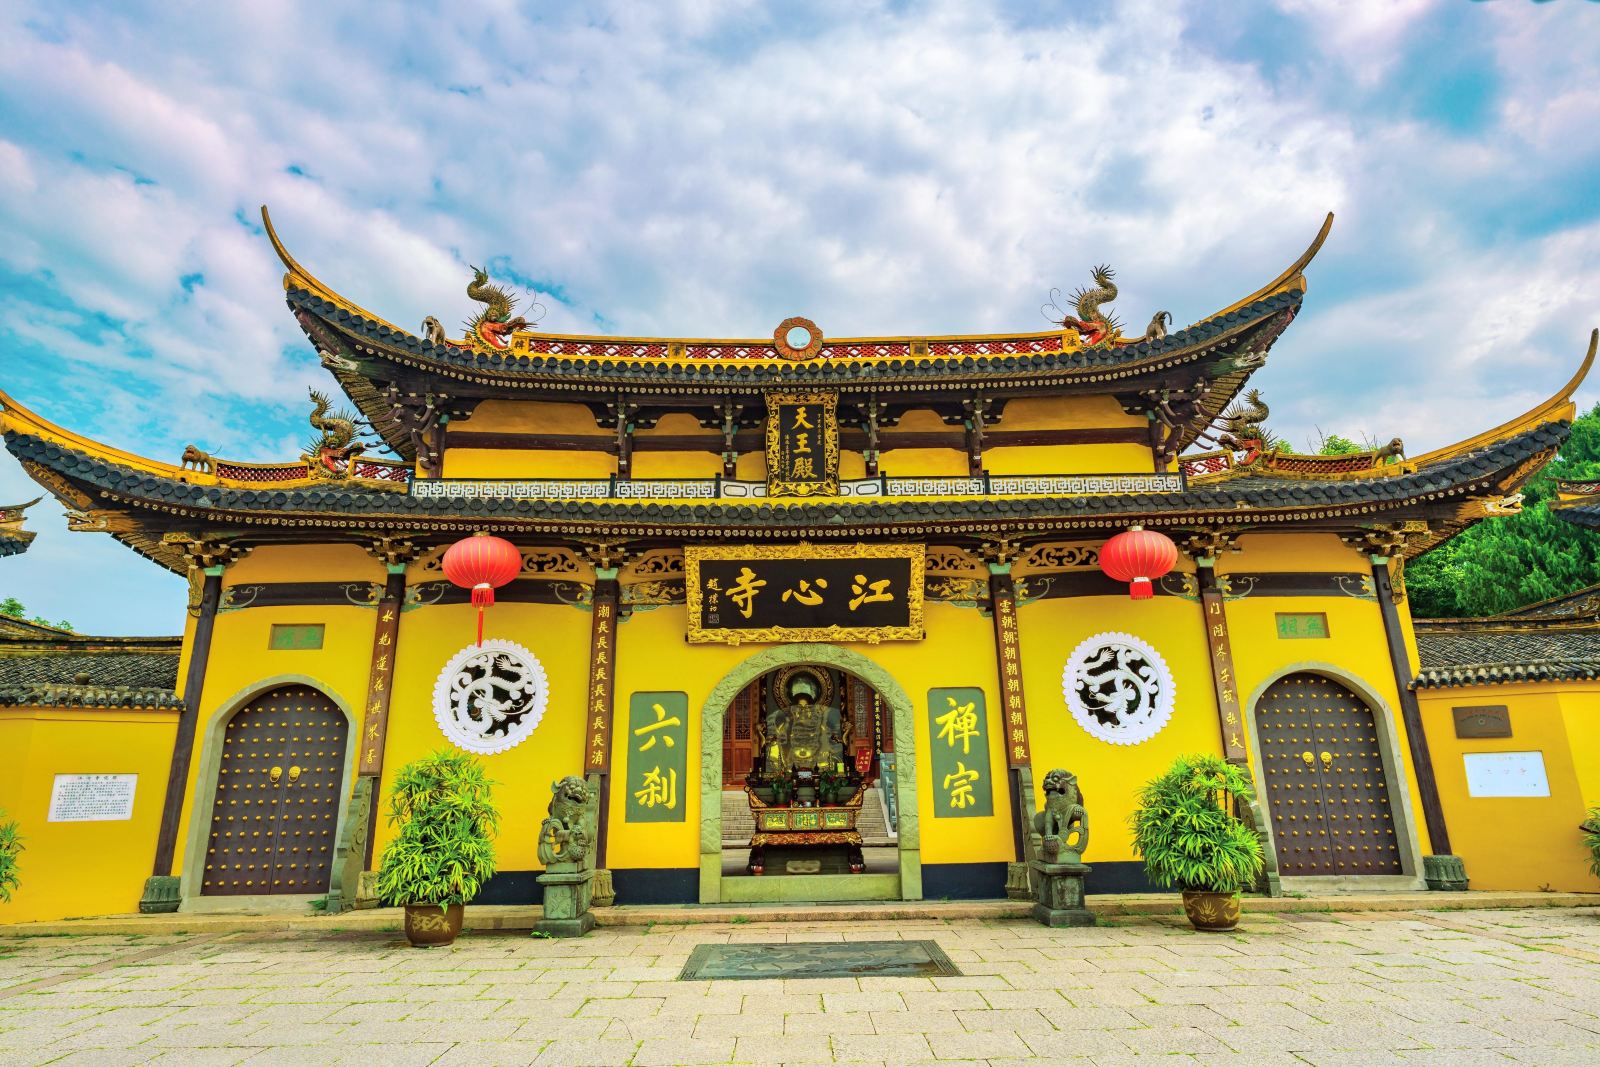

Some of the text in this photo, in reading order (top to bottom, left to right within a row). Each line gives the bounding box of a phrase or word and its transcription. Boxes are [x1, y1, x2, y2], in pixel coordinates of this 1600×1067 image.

[791, 406, 818, 479] 天王殿
[725, 567, 895, 619] 江心寺
[591, 605, 610, 766] 潮長長長長長長長長消
[1000, 599, 1028, 759] 雲朝朝朝朝朝朝朝朝散
[634, 703, 681, 810] 六刹
[935, 696, 981, 810] 禅宗
